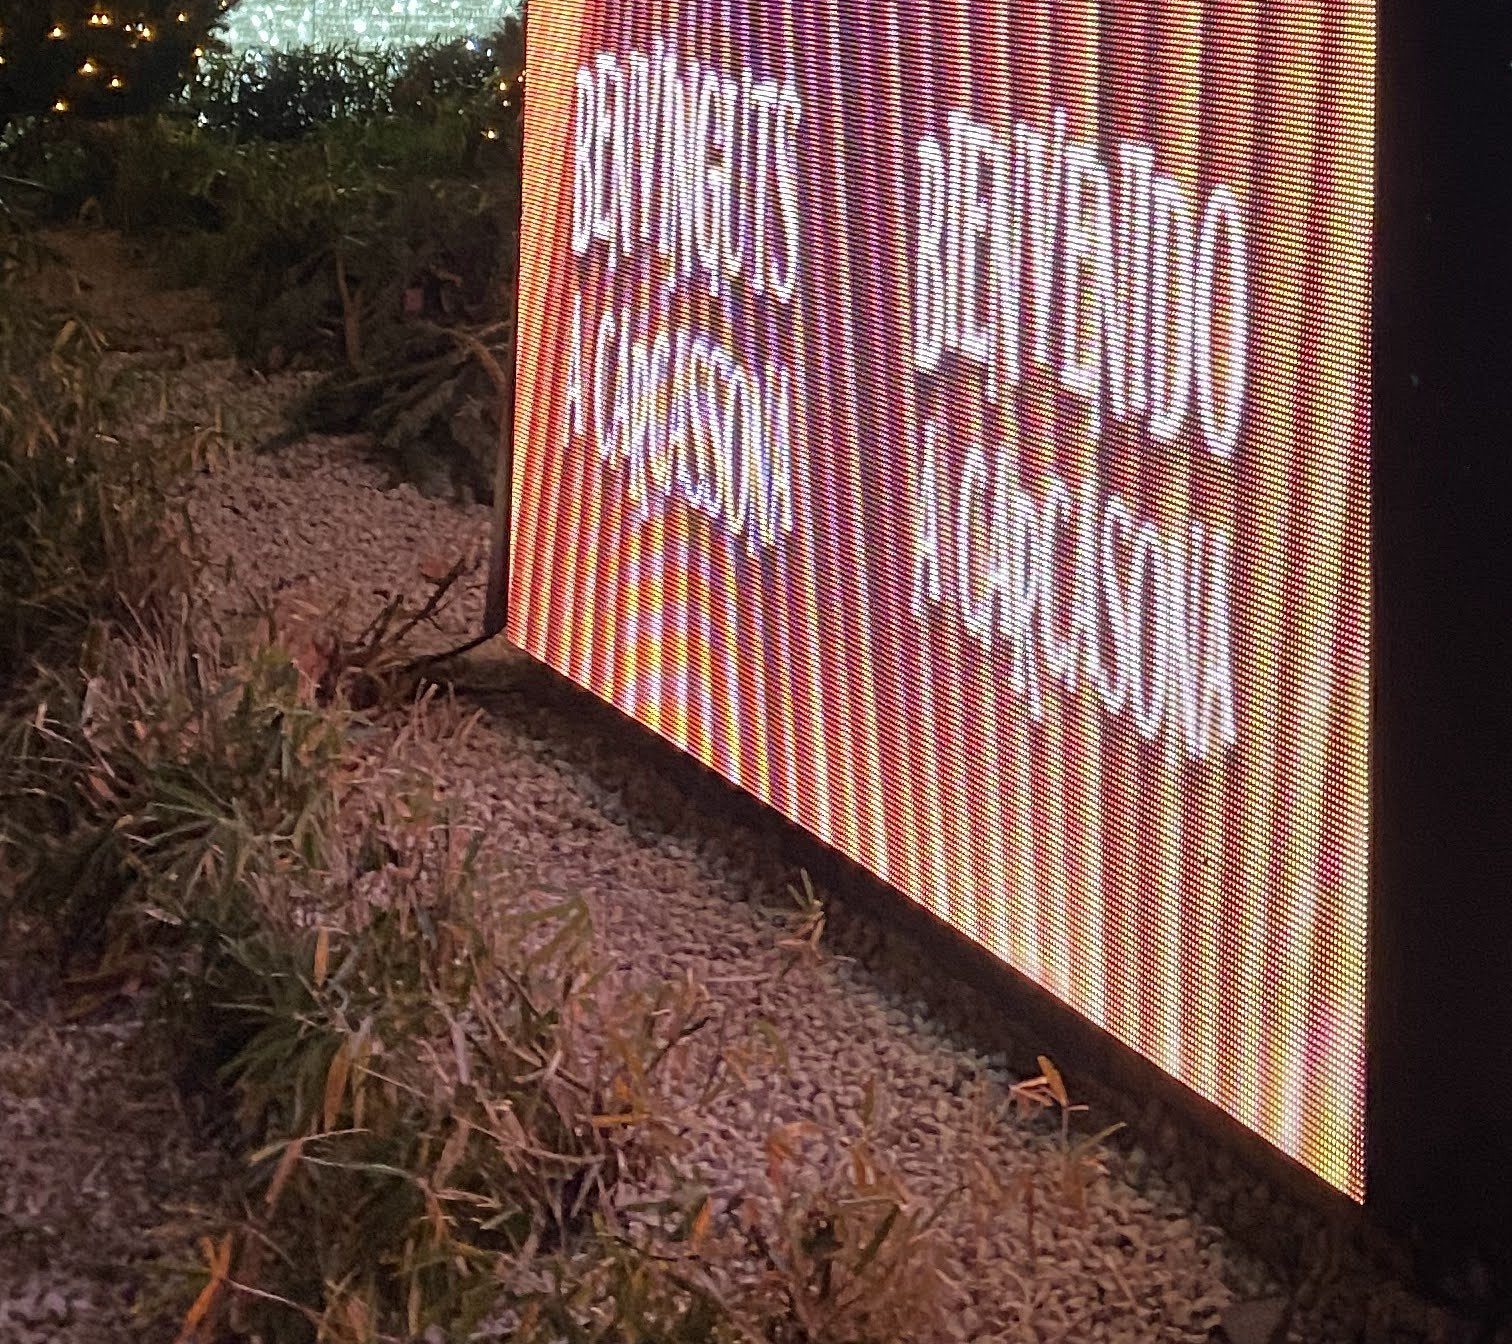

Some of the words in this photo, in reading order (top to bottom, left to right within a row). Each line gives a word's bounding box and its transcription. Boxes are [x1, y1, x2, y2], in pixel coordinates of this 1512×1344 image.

[571, 38, 801, 304] BENVINGUTS
[914, 108, 1249, 463] BIENVENIDO
[562, 292, 585, 447] A
[594, 306, 793, 555] CARCASSONA
[911, 419, 943, 620] A
[957, 443, 1238, 765] CARCASONA
